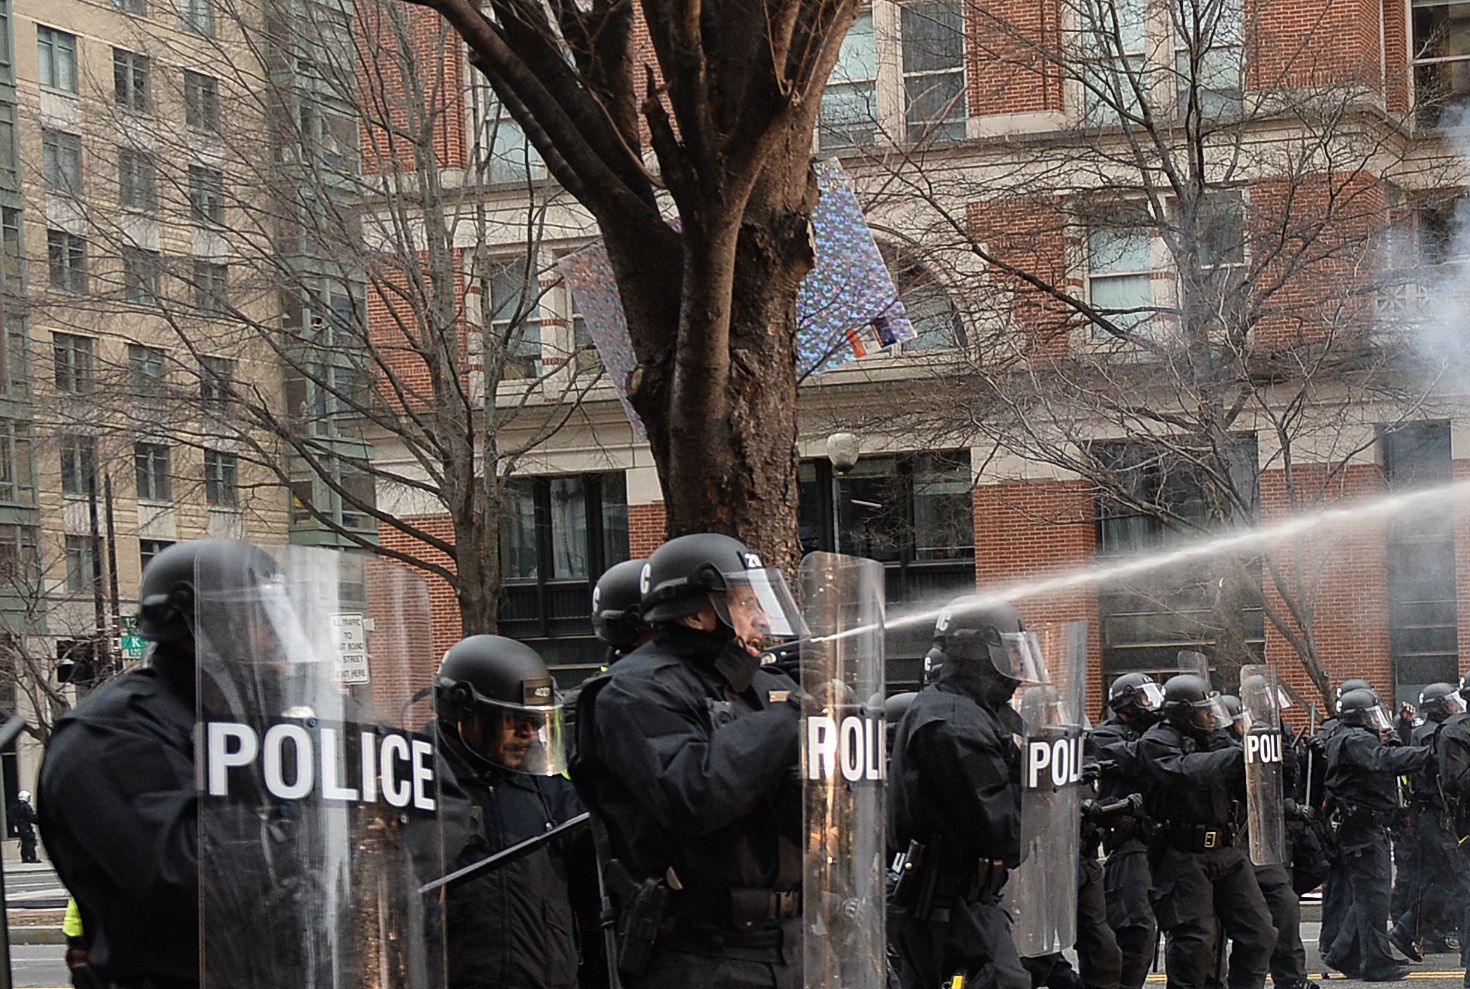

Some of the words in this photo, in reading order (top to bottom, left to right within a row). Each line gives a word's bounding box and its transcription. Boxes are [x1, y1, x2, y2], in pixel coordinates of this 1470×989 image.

[343, 631, 353, 640] TO
[343, 655, 363, 663] STREET
[208, 722, 436, 811] POLICE
